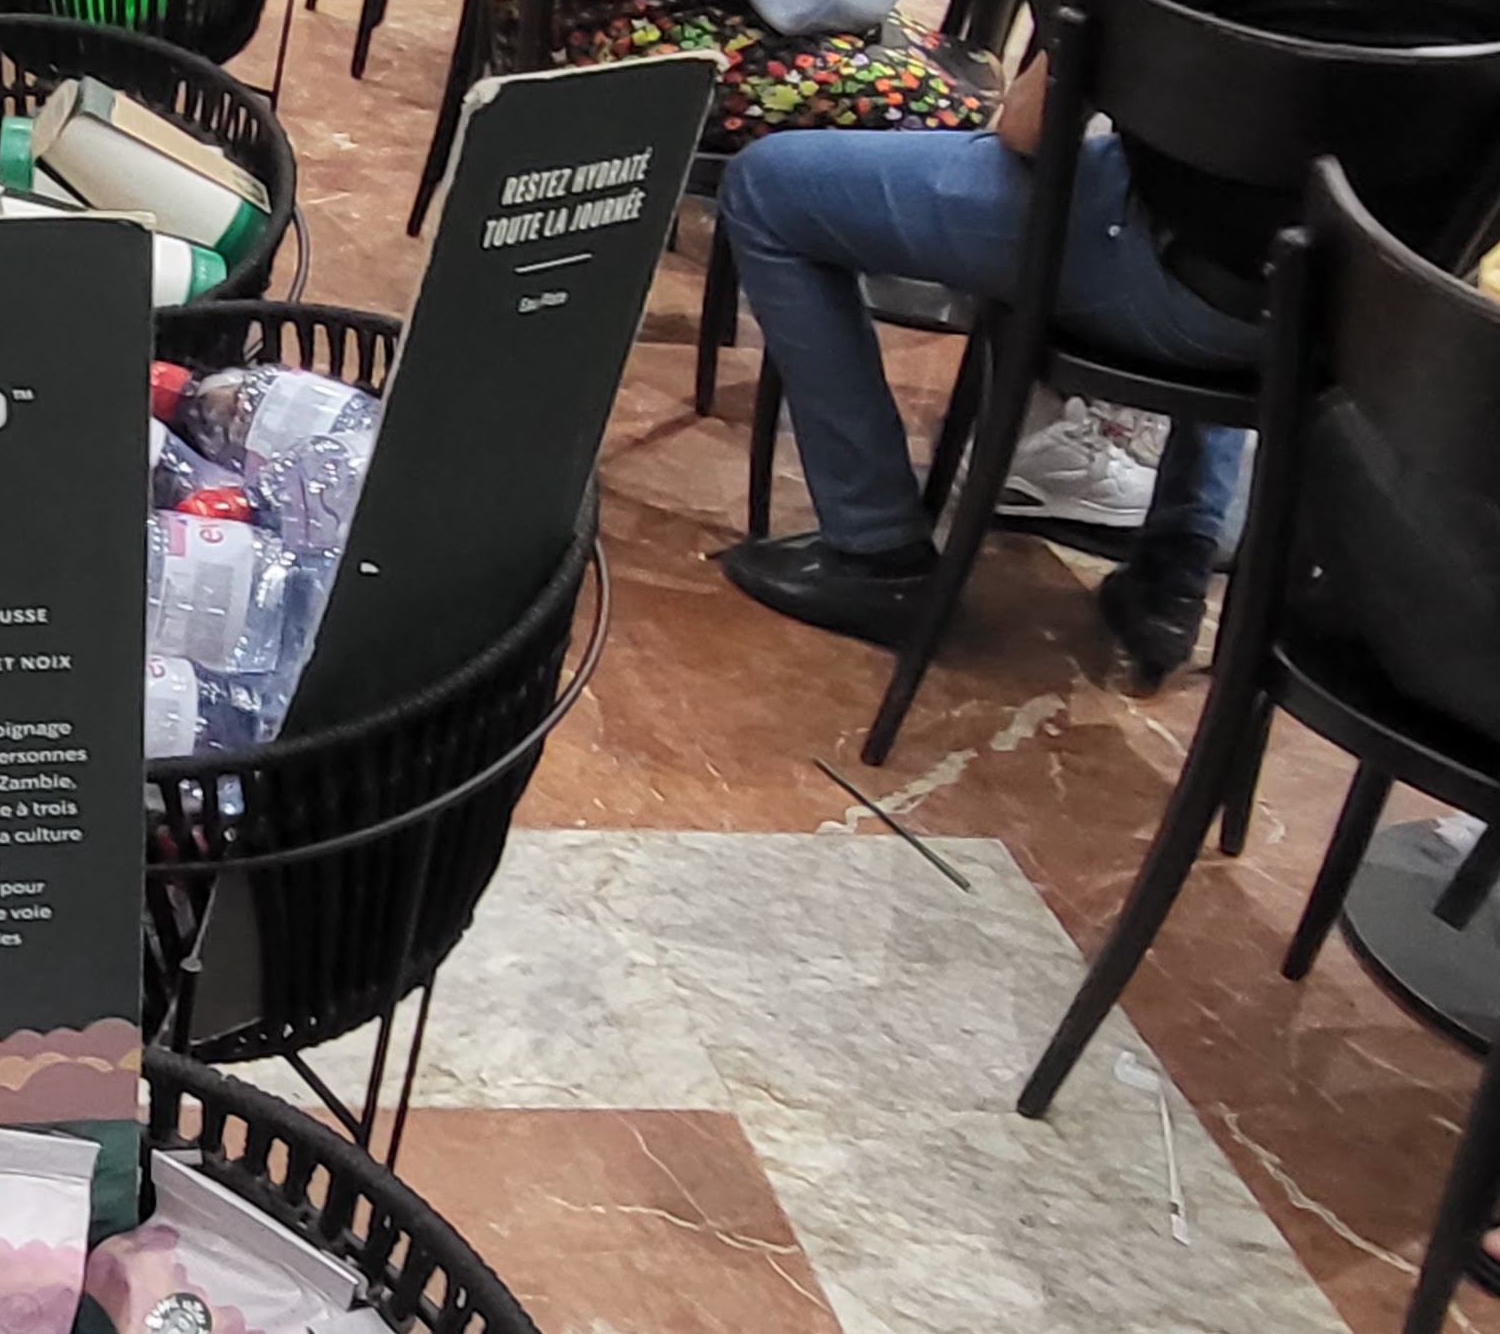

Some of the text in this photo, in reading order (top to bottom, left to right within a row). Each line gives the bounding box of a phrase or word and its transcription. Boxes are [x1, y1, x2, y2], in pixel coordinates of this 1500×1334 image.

[501, 146, 652, 206] RESTEZ HYDRATÉ
[482, 187, 646, 249] TOUTE LA JOURNÉE
[20, 654, 72, 671] NOIX
[15, 801, 29, 817] à
[32, 799, 78, 816] trois
[14, 826, 83, 844] culture
[0, 880, 46, 898] pour
[10, 904, 52, 920] voie
